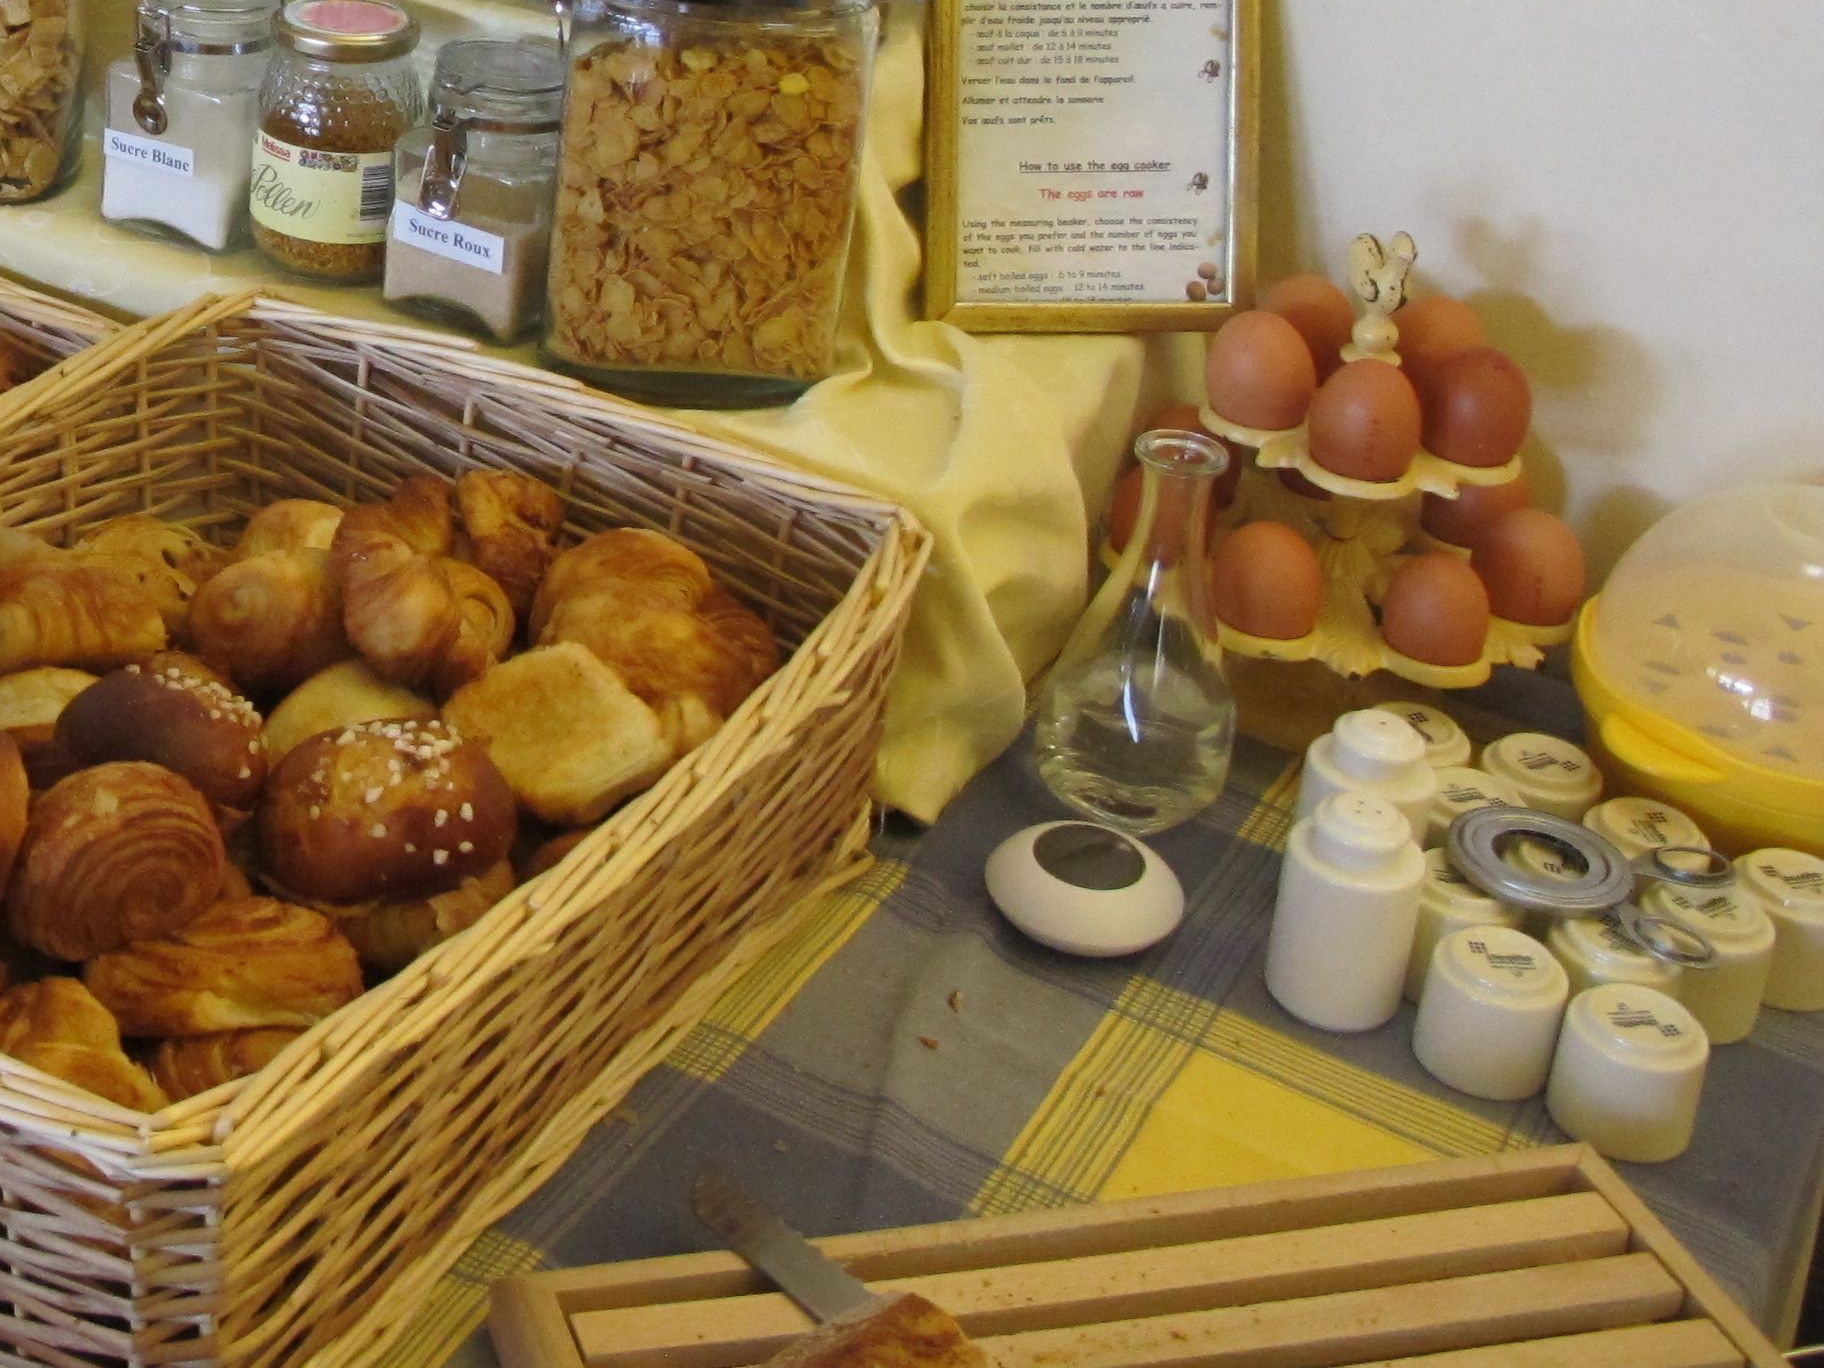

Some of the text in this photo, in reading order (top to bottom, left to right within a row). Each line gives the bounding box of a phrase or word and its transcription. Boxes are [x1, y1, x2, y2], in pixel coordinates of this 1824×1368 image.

[111, 136, 190, 172] Sucre Blanc
[1019, 160, 1171, 172] How to use the egg cooker
[250, 163, 322, 220] Pollen
[1039, 188, 1144, 202] The eggs are raw
[409, 218, 491, 259] Sucre Roux
